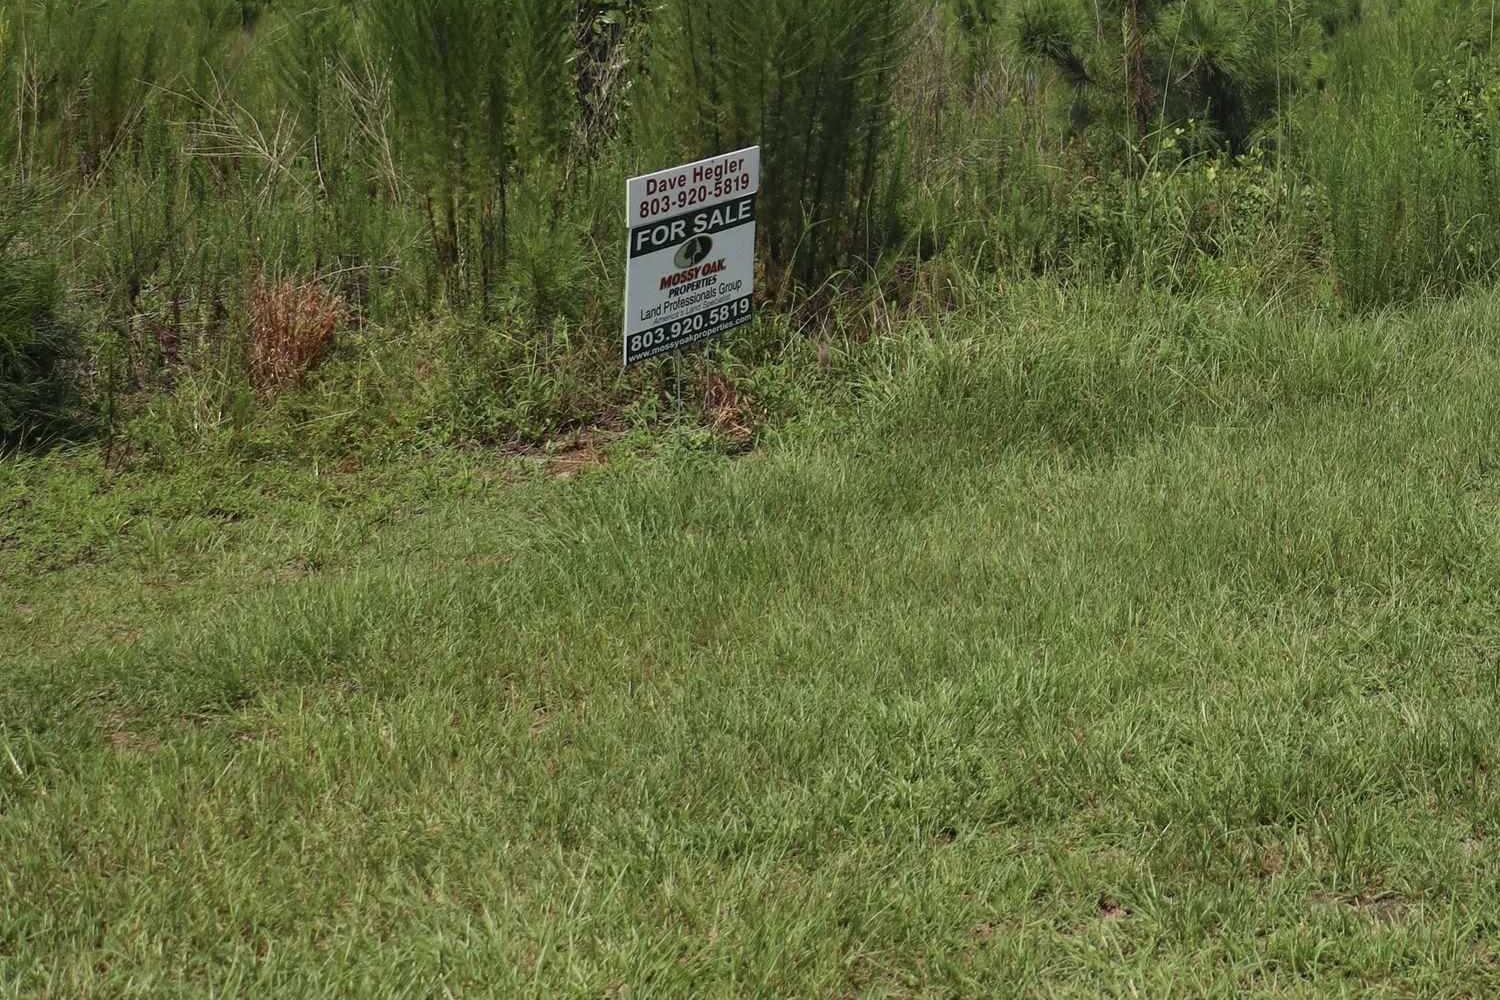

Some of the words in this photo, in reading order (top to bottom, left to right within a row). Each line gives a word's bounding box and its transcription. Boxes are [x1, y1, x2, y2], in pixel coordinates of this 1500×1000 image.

[639, 173, 750, 219] 803-920-5819
[646, 174, 687, 196] Dave
[692, 158, 745, 186] Hegler
[636, 221, 688, 252] FOR
[693, 199, 753, 233] SALE
[640, 303, 662, 321] Land
[663, 287, 717, 314] Professionals
[718, 279, 743, 296] Group
[660, 266, 701, 290] MOSSY
[668, 275, 718, 299] PROPERTIES
[628, 313, 752, 362] www.mossyoakproperties.com
[631, 297, 749, 352] 803.920.5819
